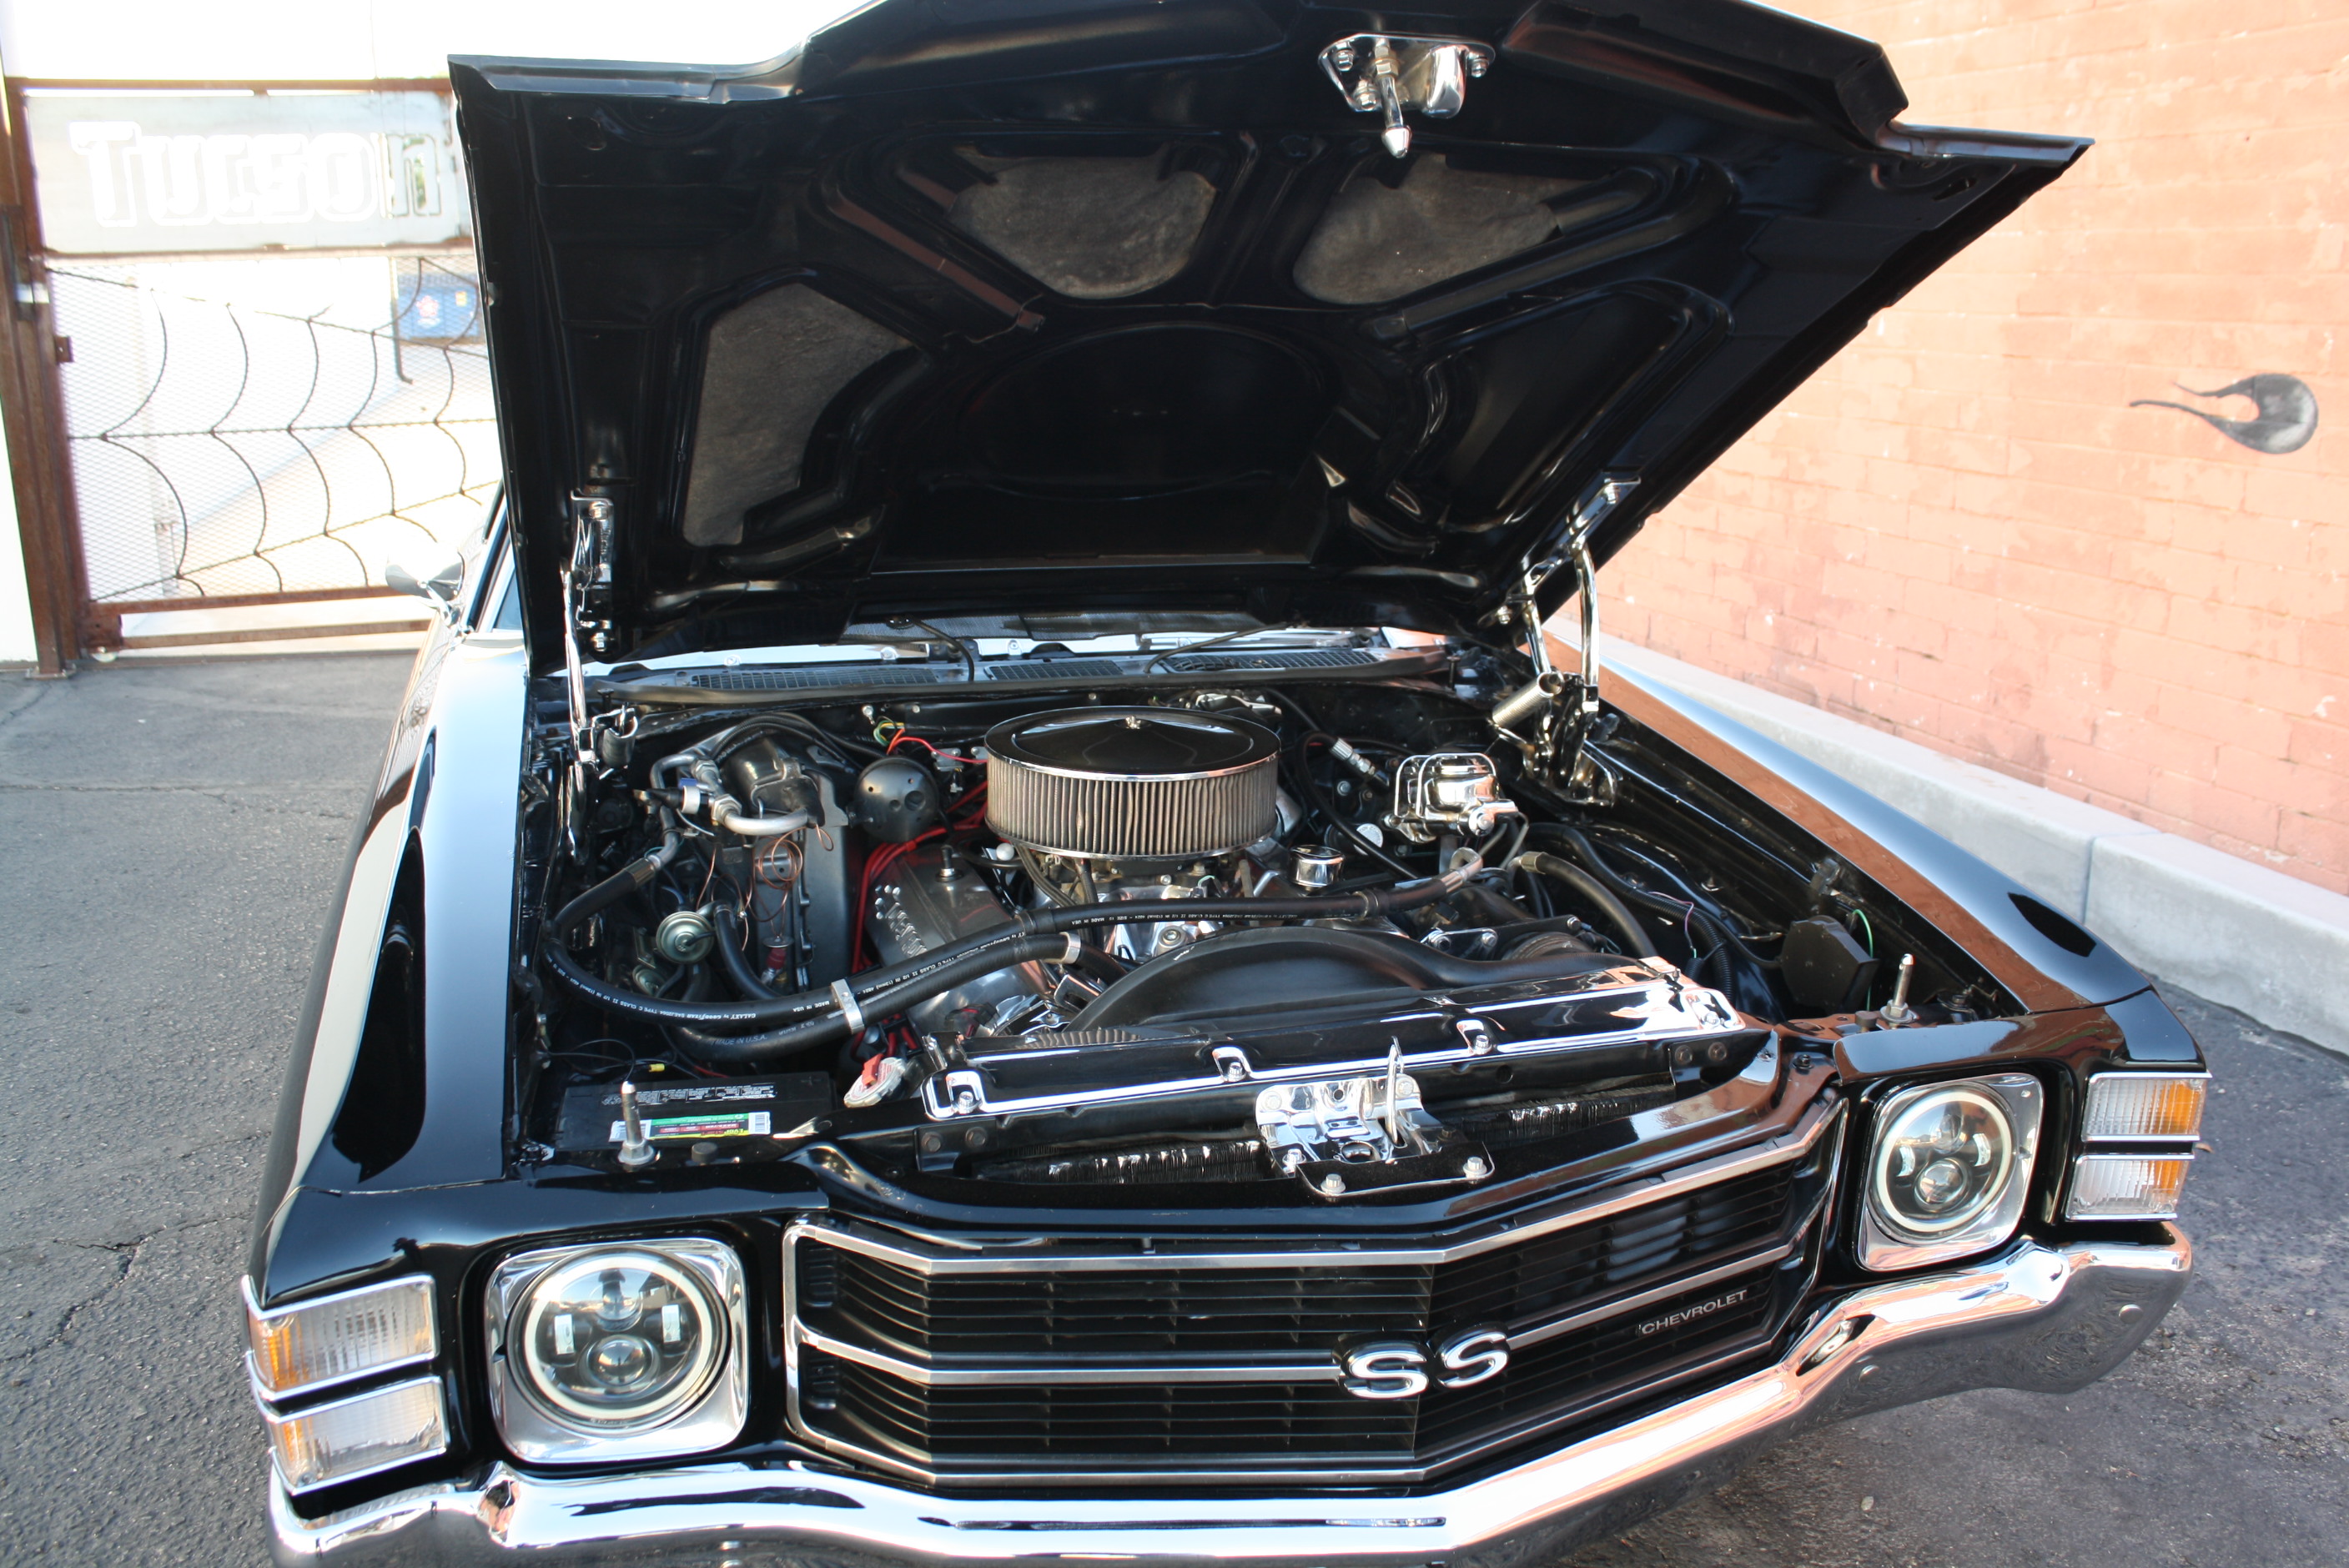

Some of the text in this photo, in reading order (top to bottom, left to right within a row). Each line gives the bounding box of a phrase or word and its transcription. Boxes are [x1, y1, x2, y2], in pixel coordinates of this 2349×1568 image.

[919, 963, 936, 973] CLASS
[620, 1000, 637, 1010] CLASS
[746, 1034, 767, 1043] U.S.A.
[1641, 1289, 1748, 1334] CHEVROLET
